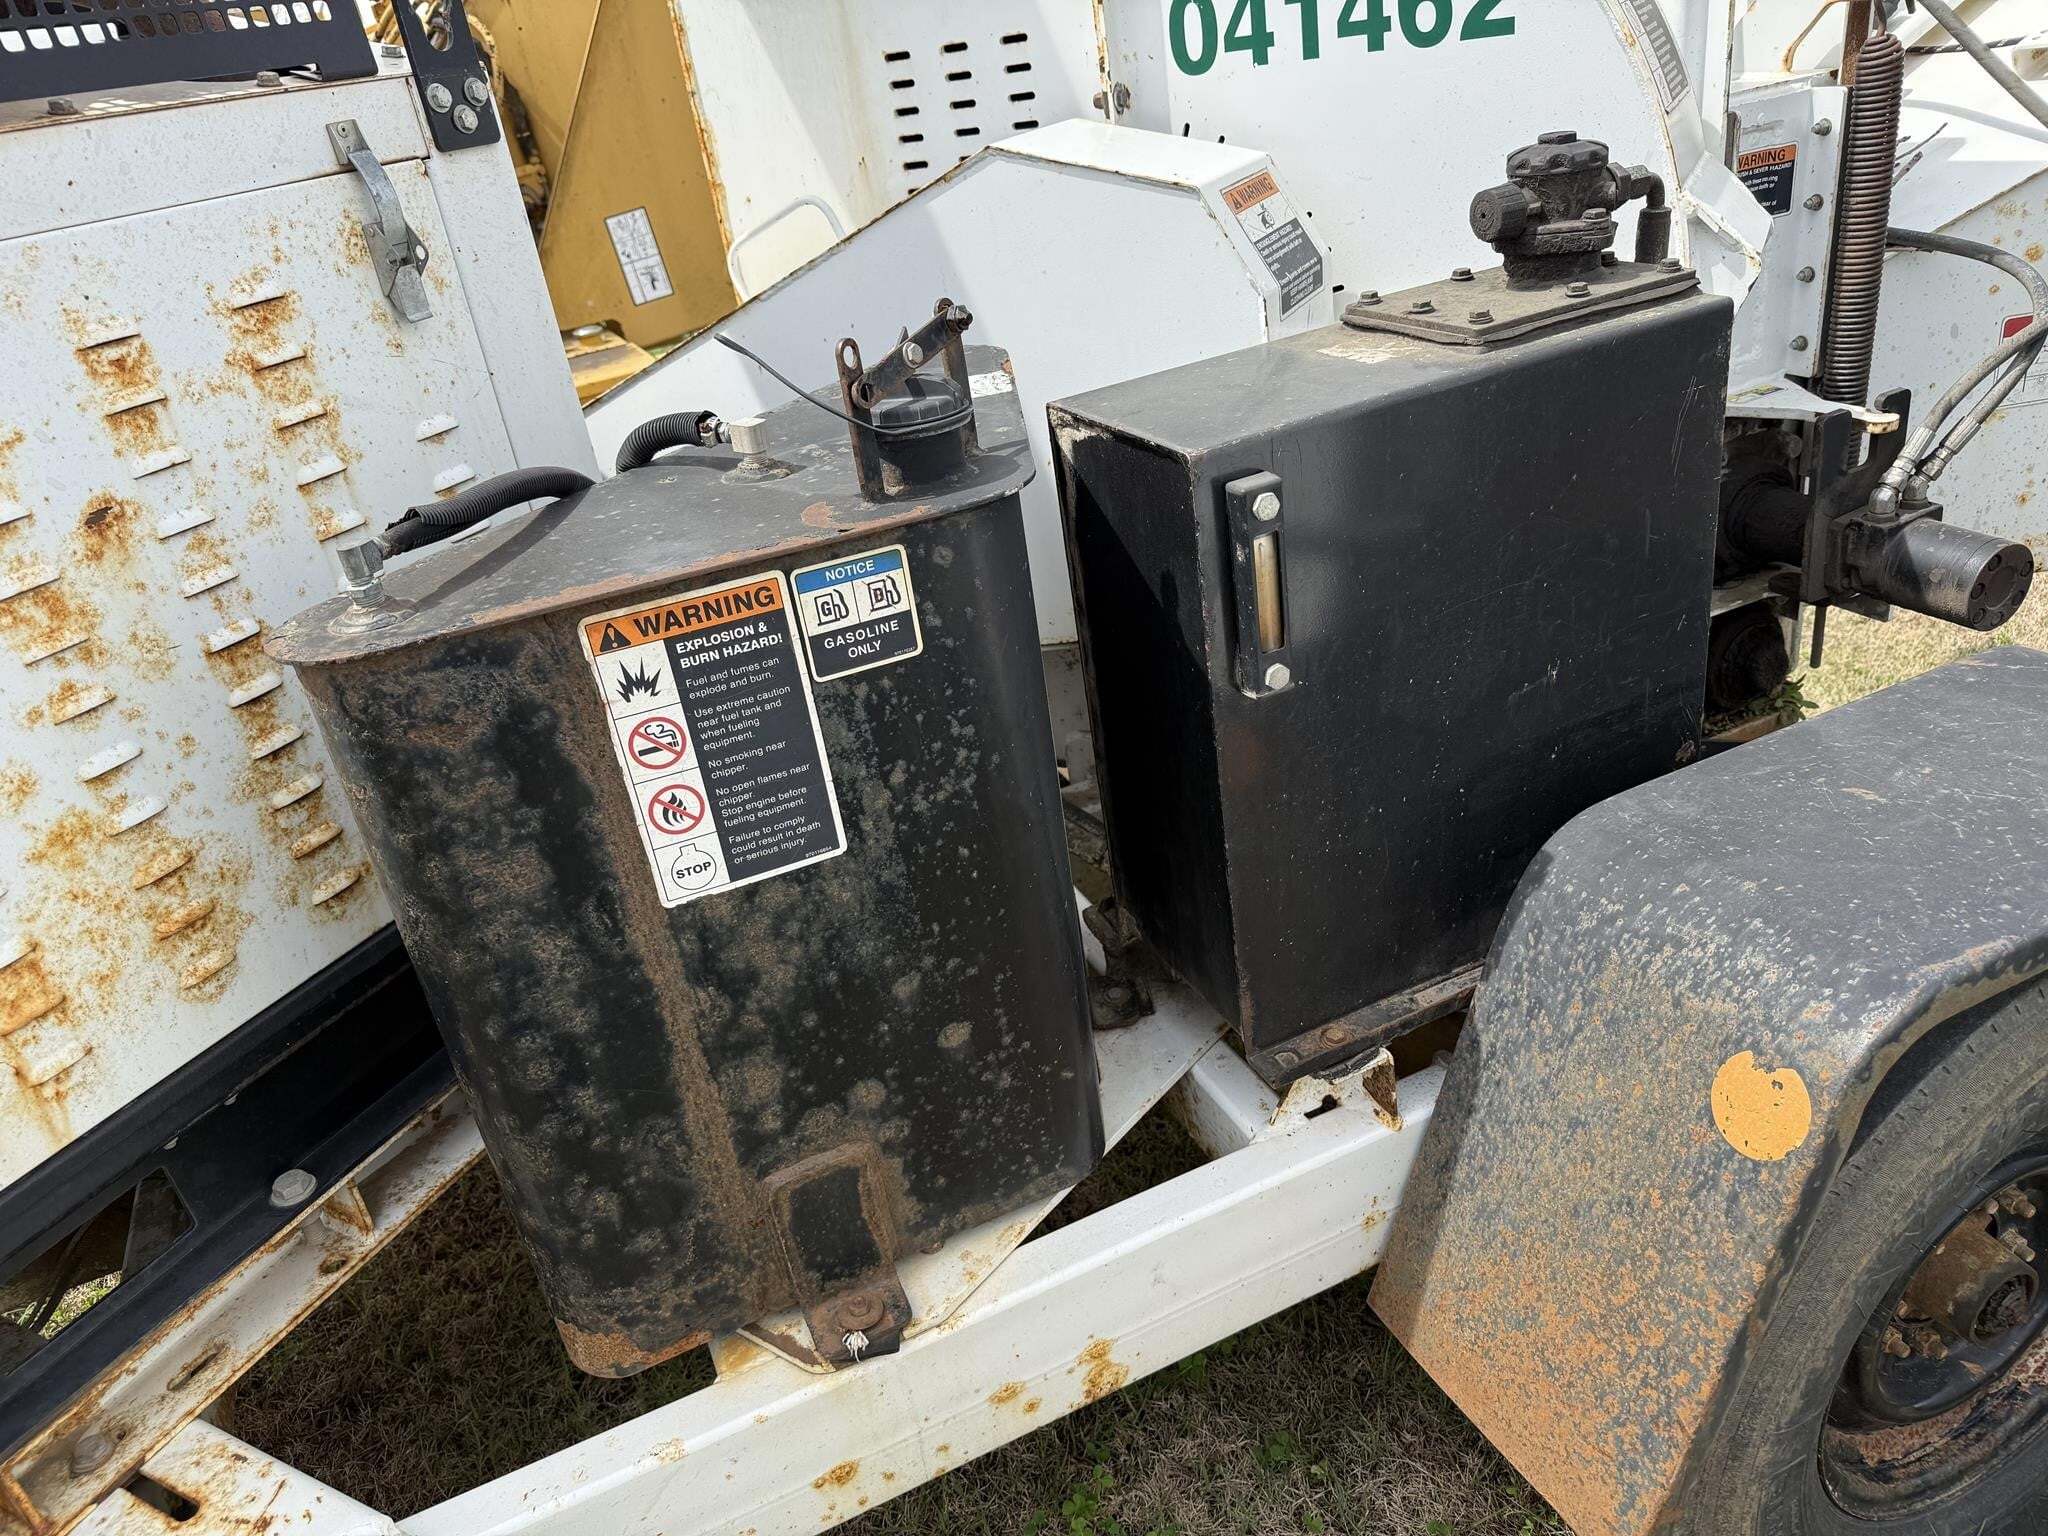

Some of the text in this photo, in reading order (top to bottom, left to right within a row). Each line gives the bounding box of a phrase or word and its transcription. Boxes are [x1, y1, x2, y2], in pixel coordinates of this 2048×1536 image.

[1239, 177, 1273, 205] WARNING
[825, 560, 875, 582] NOTICE
[633, 586, 775, 637] WARNING
[675, 622, 768, 654] EXPLOSION &
[824, 619, 900, 649] GASOLINE
[680, 633, 783, 669] BURN HAZARD!
[848, 640, 881, 658] ONLY
[686, 657, 779, 688] Fuel and fumes can
[689, 672, 774, 699] explode and burn.
[694, 686, 791, 718] Use extreme caution
[697, 699, 782, 729] near fuel tank and
[700, 718, 760, 740] when fueling
[703, 731, 755, 751] equipment.
[708, 741, 786, 768] No smoking near
[711, 764, 748, 779] chipper.
[715, 763, 810, 796] No open flames near
[718, 792, 752, 807] chipper.
[721, 787, 807, 817] Stop engine before
[724, 798, 807, 827] fueling equipment.
[728, 816, 805, 844] Failure to comply
[731, 840, 756, 854] could
[758, 833, 783, 846] result
[796, 821, 821, 834] death
[734, 837, 807, 864] or serious injury.
[676, 862, 711, 878] STOP
